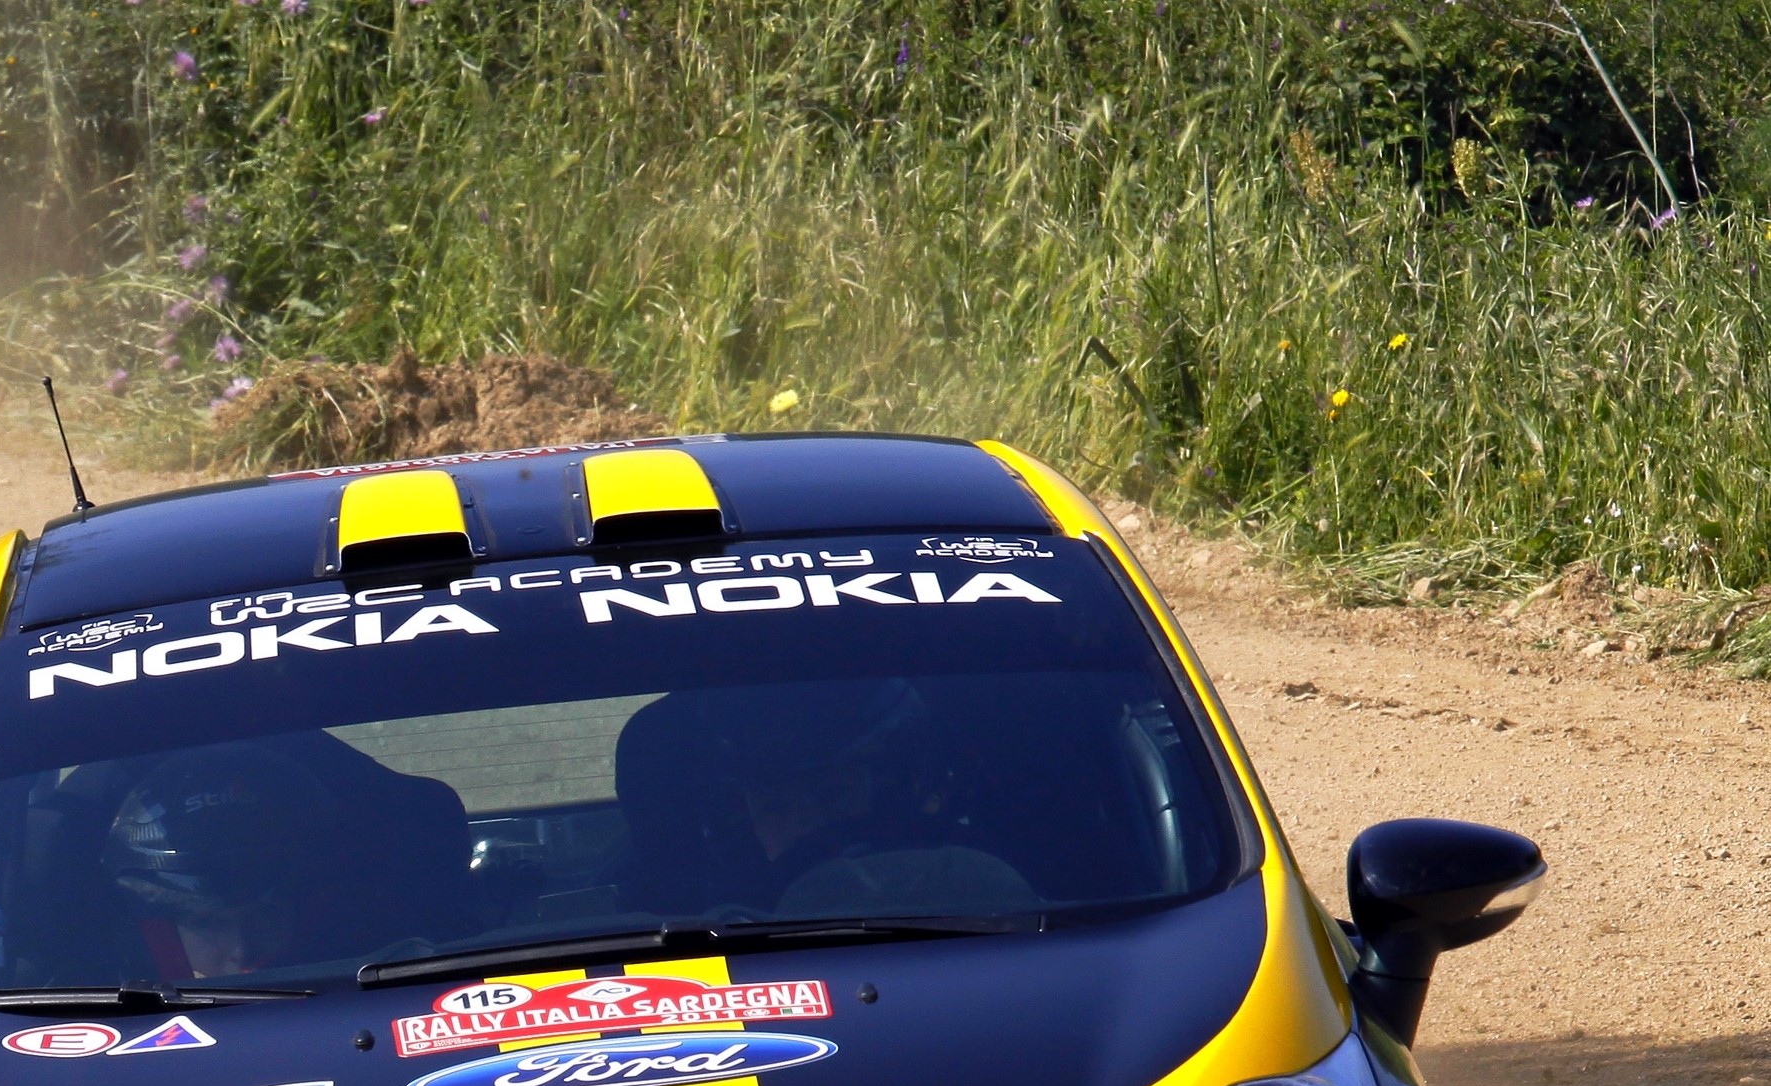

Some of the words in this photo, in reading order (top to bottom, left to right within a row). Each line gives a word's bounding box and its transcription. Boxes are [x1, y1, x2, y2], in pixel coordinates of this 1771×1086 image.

[915, 549, 1054, 557] ACADEMY
[449, 549, 874, 596] ACADEMY
[579, 572, 1064, 624] NOKIA
[27, 622, 163, 656] ACADEMY
[28, 603, 500, 700] NOKIA
[405, 1011, 506, 1041] RALLY
[516, 1003, 626, 1028] ITALIA
[632, 983, 814, 1016] SARDEGNA
[453, 987, 517, 1012] 115
[661, 1009, 737, 1024] 2011
[39, 1032, 88, 1050] E
